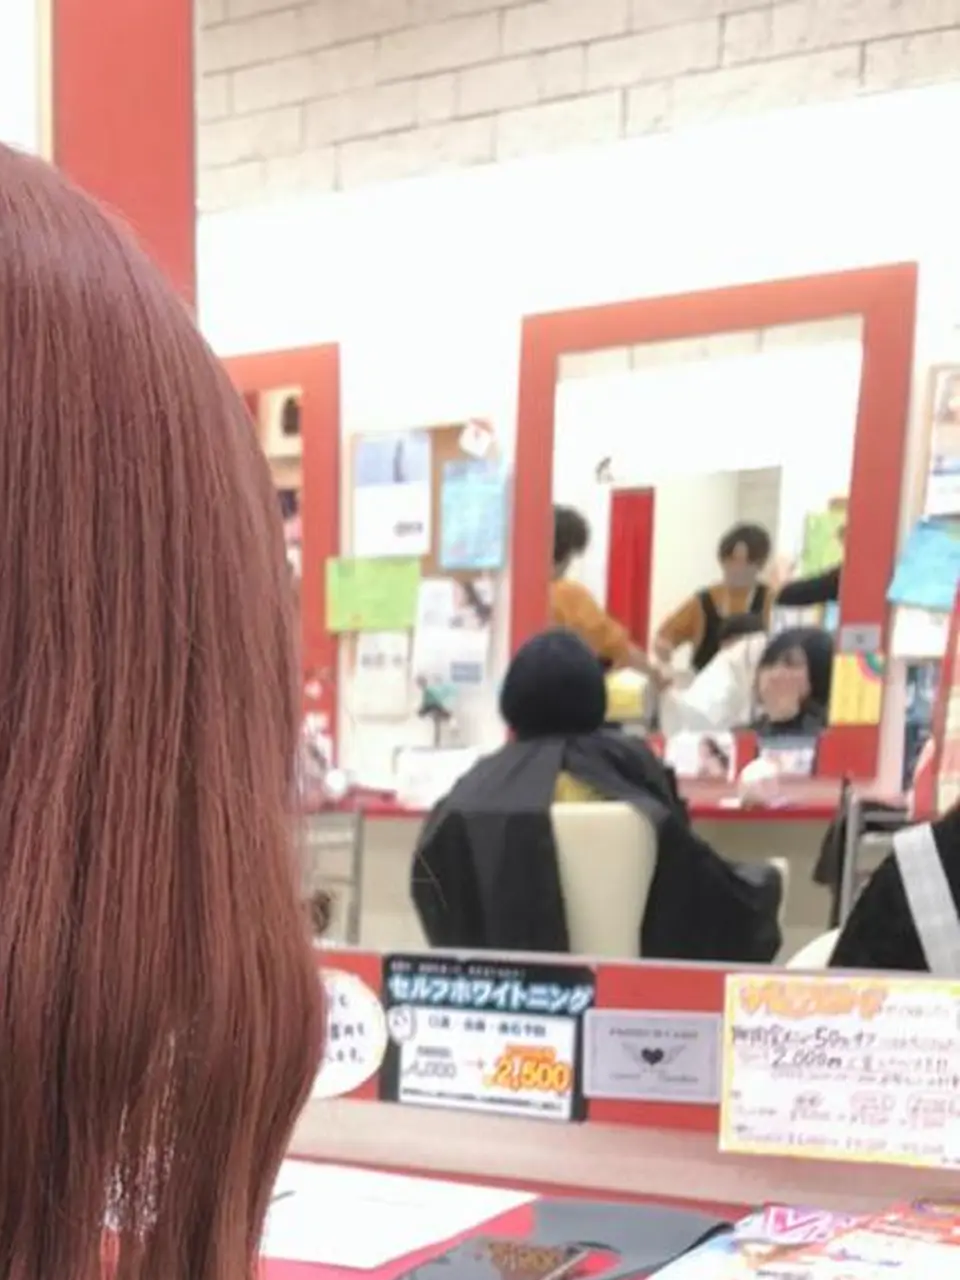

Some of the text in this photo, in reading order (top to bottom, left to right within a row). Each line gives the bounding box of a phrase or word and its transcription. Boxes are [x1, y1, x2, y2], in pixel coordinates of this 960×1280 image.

[389, 973, 592, 1012] セルフホワイトニング
